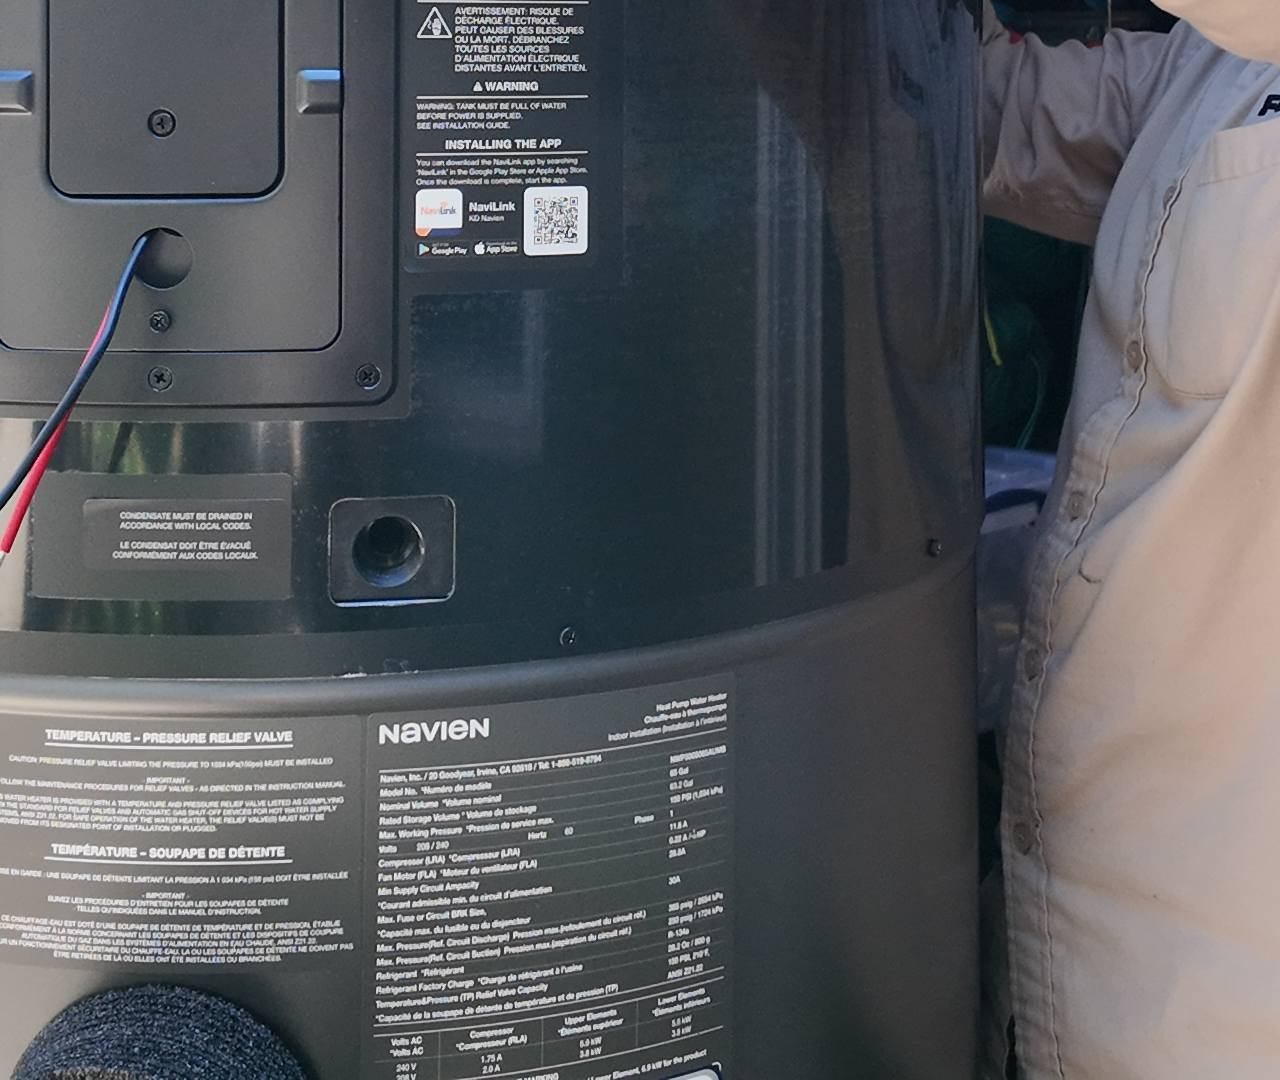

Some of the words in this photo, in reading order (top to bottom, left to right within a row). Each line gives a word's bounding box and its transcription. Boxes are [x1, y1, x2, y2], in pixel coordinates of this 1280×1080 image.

[530, 7, 560, 16] RISQUE
[563, 7, 574, 16] DE
[455, 26, 478, 34] PEUT
[480, 26, 515, 34] CAUSER
[517, 26, 534, 34] DES
[536, 26, 584, 34] BLESSURES
[455, 36, 468, 44] OU
[470, 36, 481, 44] LA
[483, 36, 511, 44] MORT.
[455, 45, 489, 53] TOUTES
[491, 45, 507, 53] LES
[509, 45, 550, 53] SOURCES
[455, 64, 502, 72] DISTANTES
[504, 64, 532, 72] AVANT
[485, 82, 538, 91] WARNING
[416, 112, 447, 120] BEFORE
[448, 112, 476, 120] POWER
[477, 112, 484, 120] IS
[486, 112, 523, 120] SUPPLIED.
[445, 140, 512, 150] INSTALLING
[515, 139, 536, 149] THE
[539, 139, 562, 149] APP
[469, 202, 516, 212] NaviLink
[120, 512, 171, 520] CONDENSATE
[173, 512, 195, 520] MUST
[196, 512, 206, 520] BE
[208, 512, 242, 520] DRAINED
[244, 512, 252, 520] IN
[120, 522, 173, 530] ACCORDANCE
[174, 522, 194, 530] WITH
[196, 522, 221, 530] LOCAL
[222, 522, 252, 530] CODES.
[45, 730, 132, 743] TEMPERATURE
[143, 732, 206, 744] PRESSURE
[210, 732, 251, 744] RELIEF
[254, 731, 293, 743] VALVE
[51, 843, 137, 859] TEMPÉRATURE
[149, 847, 206, 859] SOUPAPE
[209, 848, 226, 859] DE
[229, 844, 285, 859] DÉTENTE
